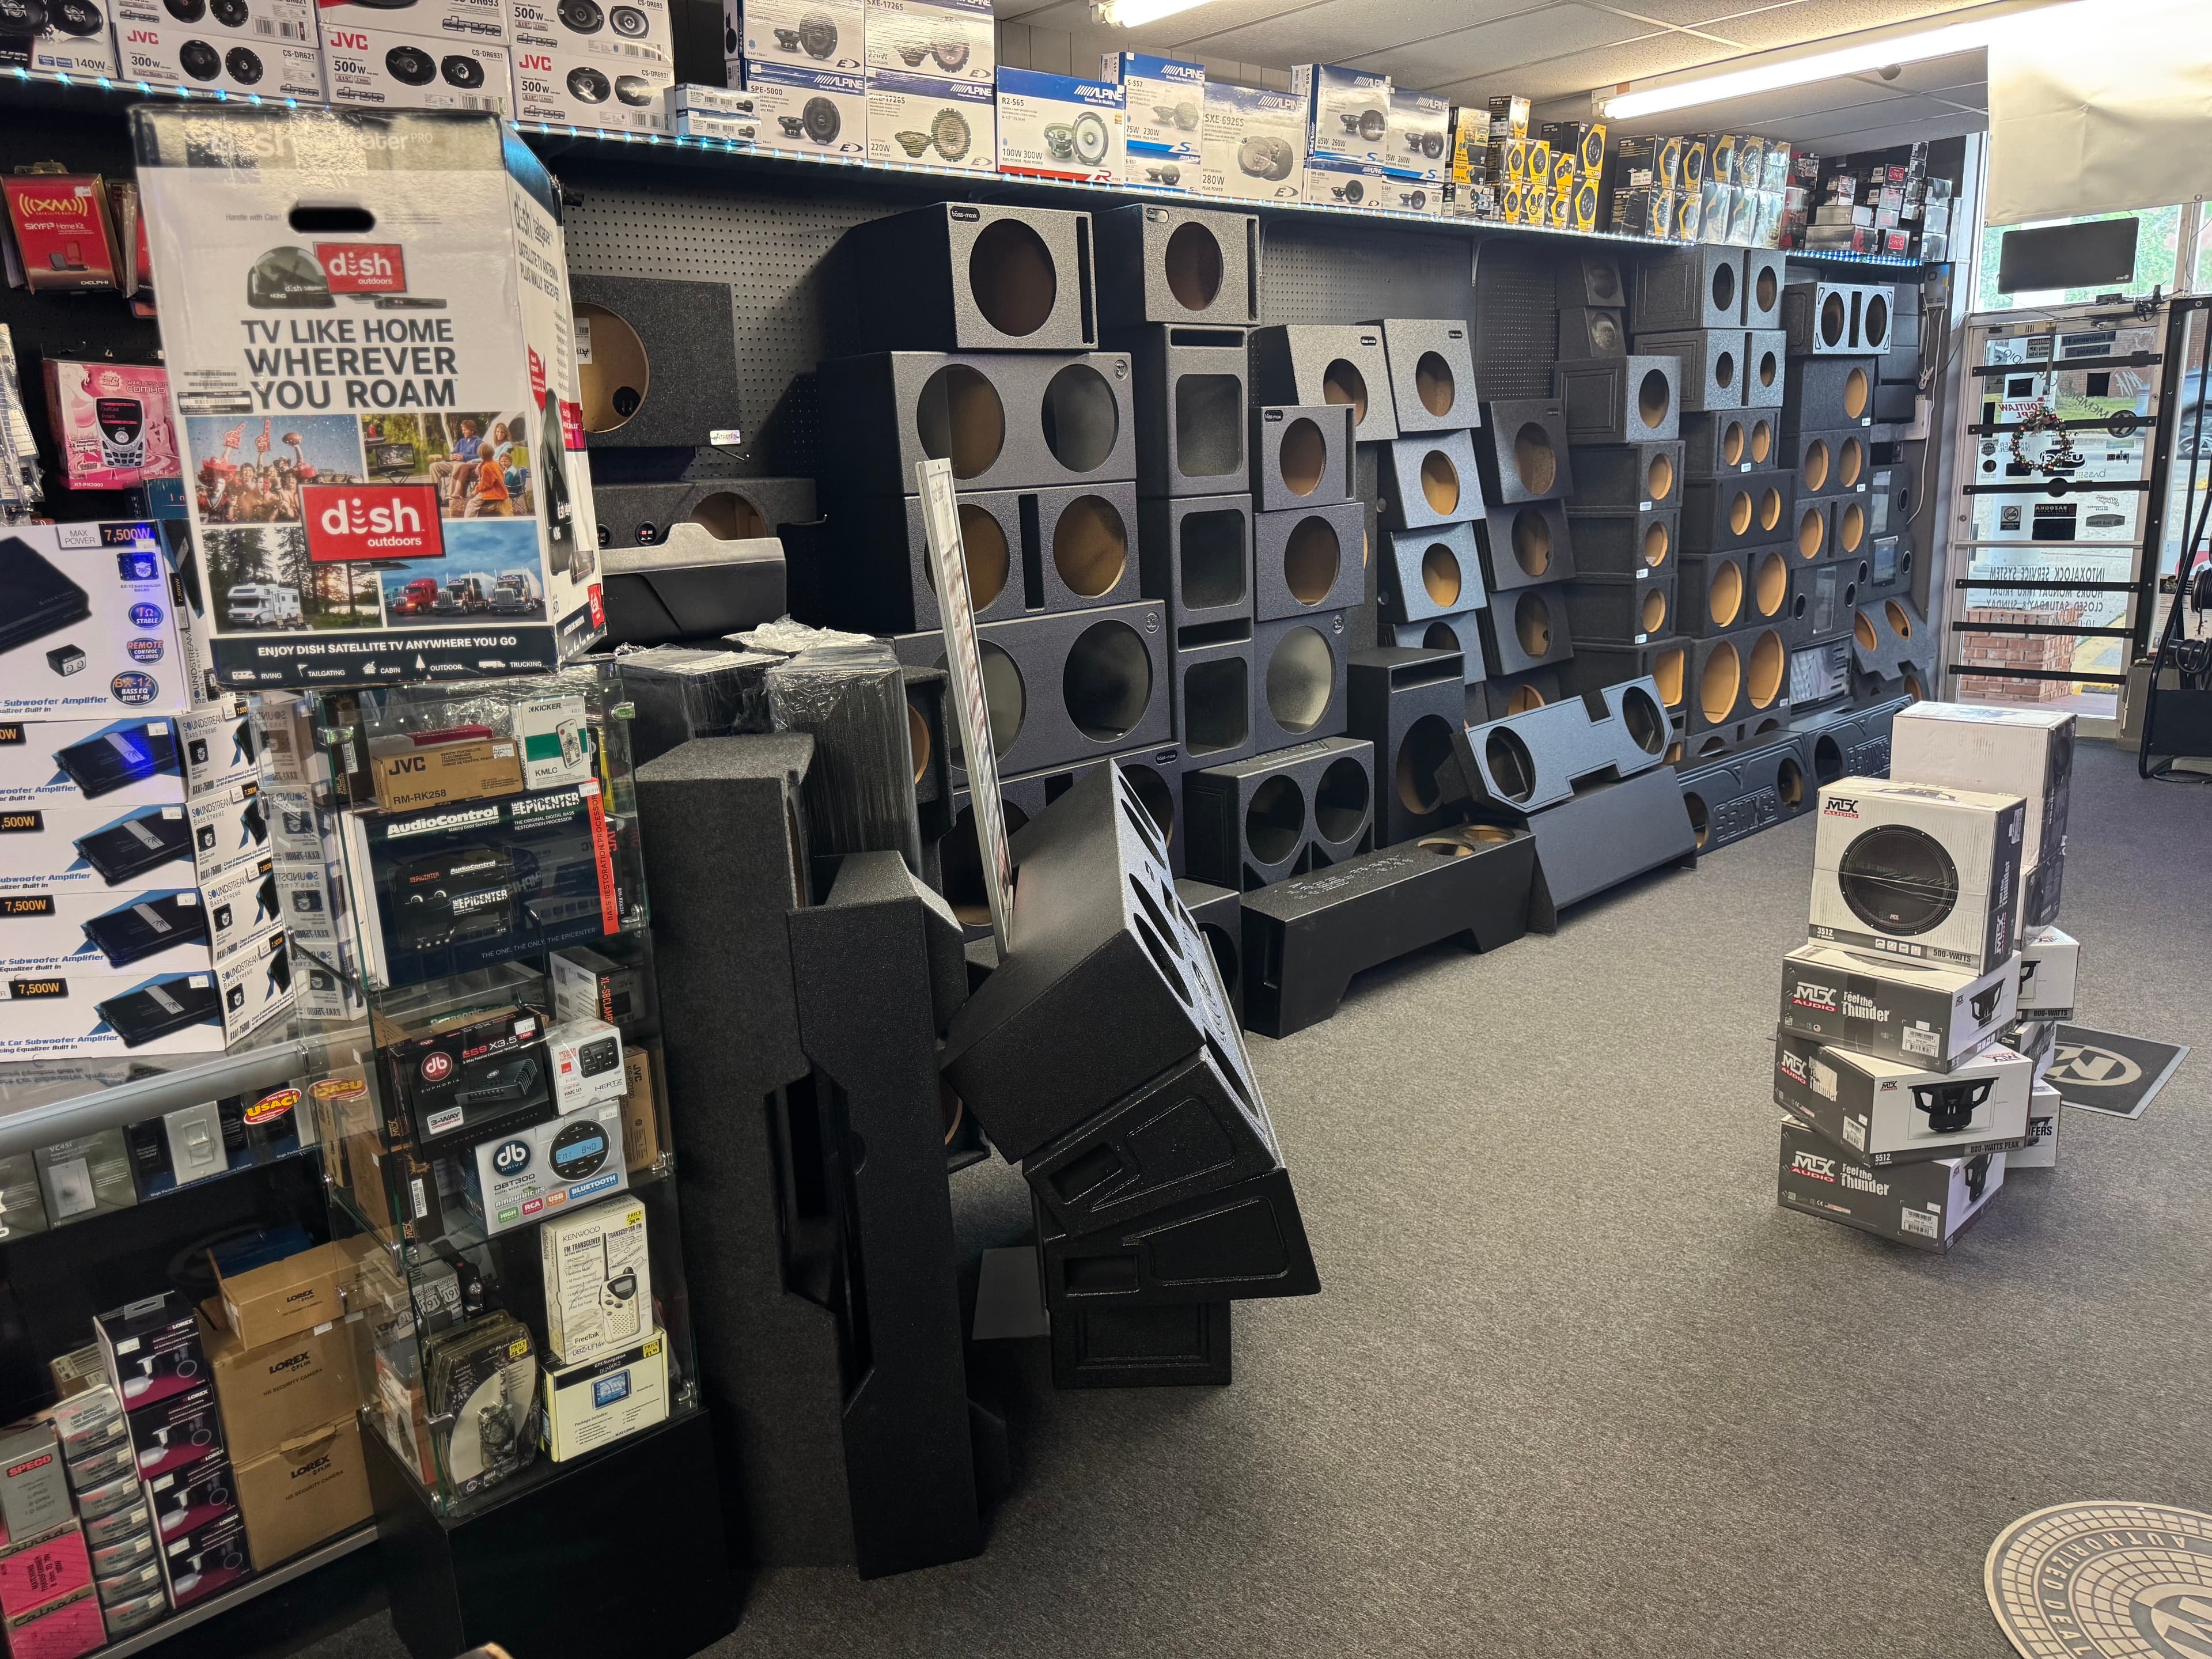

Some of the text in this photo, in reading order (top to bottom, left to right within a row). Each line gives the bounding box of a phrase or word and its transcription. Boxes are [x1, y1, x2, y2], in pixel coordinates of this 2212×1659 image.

[127, 30, 159, 45] JVC
[330, 32, 368, 50] JVC
[283, 50, 315, 60] CS-DR621
[472, 49, 503, 60] CS-DR6931
[519, 55, 552, 71] JVC
[642, 69, 669, 78] CS-DR6931
[751, 85, 783, 96] SPE-5000
[1002, 97, 1024, 107] R2-S65
[1205, 113, 1244, 127] SXE-6926S
[1126, 125, 1160, 137] 75W 230W
[870, 142, 891, 155] 220W
[1317, 137, 1346, 147] 85W 260W
[1002, 148, 1043, 161] 100W 300W
[1202, 174, 1225, 185] 280W
[225, 213, 282, 222] Handle with Care!
[329, 252, 392, 276] dish
[241, 319, 454, 344] TV LIKE HOME
[244, 347, 460, 377] WHEREVER
[127, 385, 166, 394] COMBO
[251, 380, 331, 410] YOU
[346, 378, 456, 409] ROAM
[322, 498, 421, 536] dish
[65, 536, 96, 545] POWER
[104, 528, 150, 543] 7,500W
[368, 536, 422, 547] outdoors
[127, 641, 163, 650] REMOTE
[258, 636, 517, 658] ENJOY DISH SATELLITE TV ANYWHERE YOU GO
[430, 664, 463, 672] OUTDOOR
[509, 660, 543, 668] TRUCKING
[308, 669, 346, 677] TAILGATING
[115, 678, 151, 688] BX-12
[4, 696, 108, 707] Subwoofer Amplifier
[183, 714, 225, 729] SOUNDSTREAM
[389, 756, 426, 776] JVC
[535, 767, 558, 777] KMLC
[36, 785, 78, 794] Amplifier
[393, 789, 447, 805] RM-RK258
[520, 791, 579, 815] EPICENTER
[192, 796, 233, 817] SOUNDSTREAM
[1825, 797, 1858, 813] MTX
[388, 806, 499, 836] AudioControl
[514, 816, 572, 831] RESTORATION PROCESSOR
[524, 816, 545, 824] ORIGINAL
[545, 813, 563, 821] DIGITAL
[450, 860, 495, 875] AudioControl
[598, 846, 611, 903] RESTORATION
[48, 873, 92, 881] Amplifier
[5, 900, 47, 913] 7,500W
[459, 889, 508, 910] EPICENTER
[527, 940, 546, 949] ONLY,
[560, 927, 596, 940] EPICENTER
[1817, 927, 1834, 937] 3512
[9, 954, 105, 965] Subwoofer Amplifier
[1933, 949, 1971, 963] 500-WATTS
[18, 983, 59, 995] 7,500W
[1793, 982, 1837, 1007] MTX
[1793, 999, 1836, 1012] AUDIO
[1843, 991, 1873, 1009] Feel the
[1841, 1001, 1890, 1022] Thunder
[2033, 1009, 2068, 1017] 800-WATTS
[25, 1037, 75, 1046] Subwoofer
[77, 1035, 119, 1043] Amplifier
[489, 1036, 517, 1051] X3.5
[426, 1056, 448, 1074] db
[1782, 1050, 1807, 1080] MTX
[1781, 1065, 1807, 1085] AUDIO
[594, 1078, 623, 1092] HERTZ
[1970, 1141, 2020, 1154] 800-WATTS PEAK
[497, 1144, 526, 1166] db
[1874, 1153, 1891, 1162] 5512
[501, 1162, 524, 1172] DRIVE
[1791, 1150, 1836, 1177] MTX
[1792, 1167, 1835, 1183] AUDIO
[1843, 1162, 1873, 1181] Feel the
[494, 1173, 535, 1191] DBT300
[571, 1176, 616, 1196] BLUETOOTH
[1840, 1171, 1890, 1196] Thunder
[548, 1192, 564, 1202] USB
[524, 1200, 541, 1212] RCA
[499, 1210, 517, 1219] HIGH
[627, 1210, 642, 1219] PRICE
[562, 1226, 601, 1243] KENWOOD
[570, 1236, 601, 1251] TRANSCEIVER
[286, 1289, 314, 1303] LOREX
[574, 1332, 600, 1344] FreeTalk
[268, 1350, 311, 1375] LOREX
[300, 1368, 323, 1382] CAMERA
[187, 1388, 209, 1402] LOREX
[8, 1455, 51, 1477] SPECO
[290, 1454, 331, 1480] LOREX
[321, 1469, 344, 1484] CAMERA
